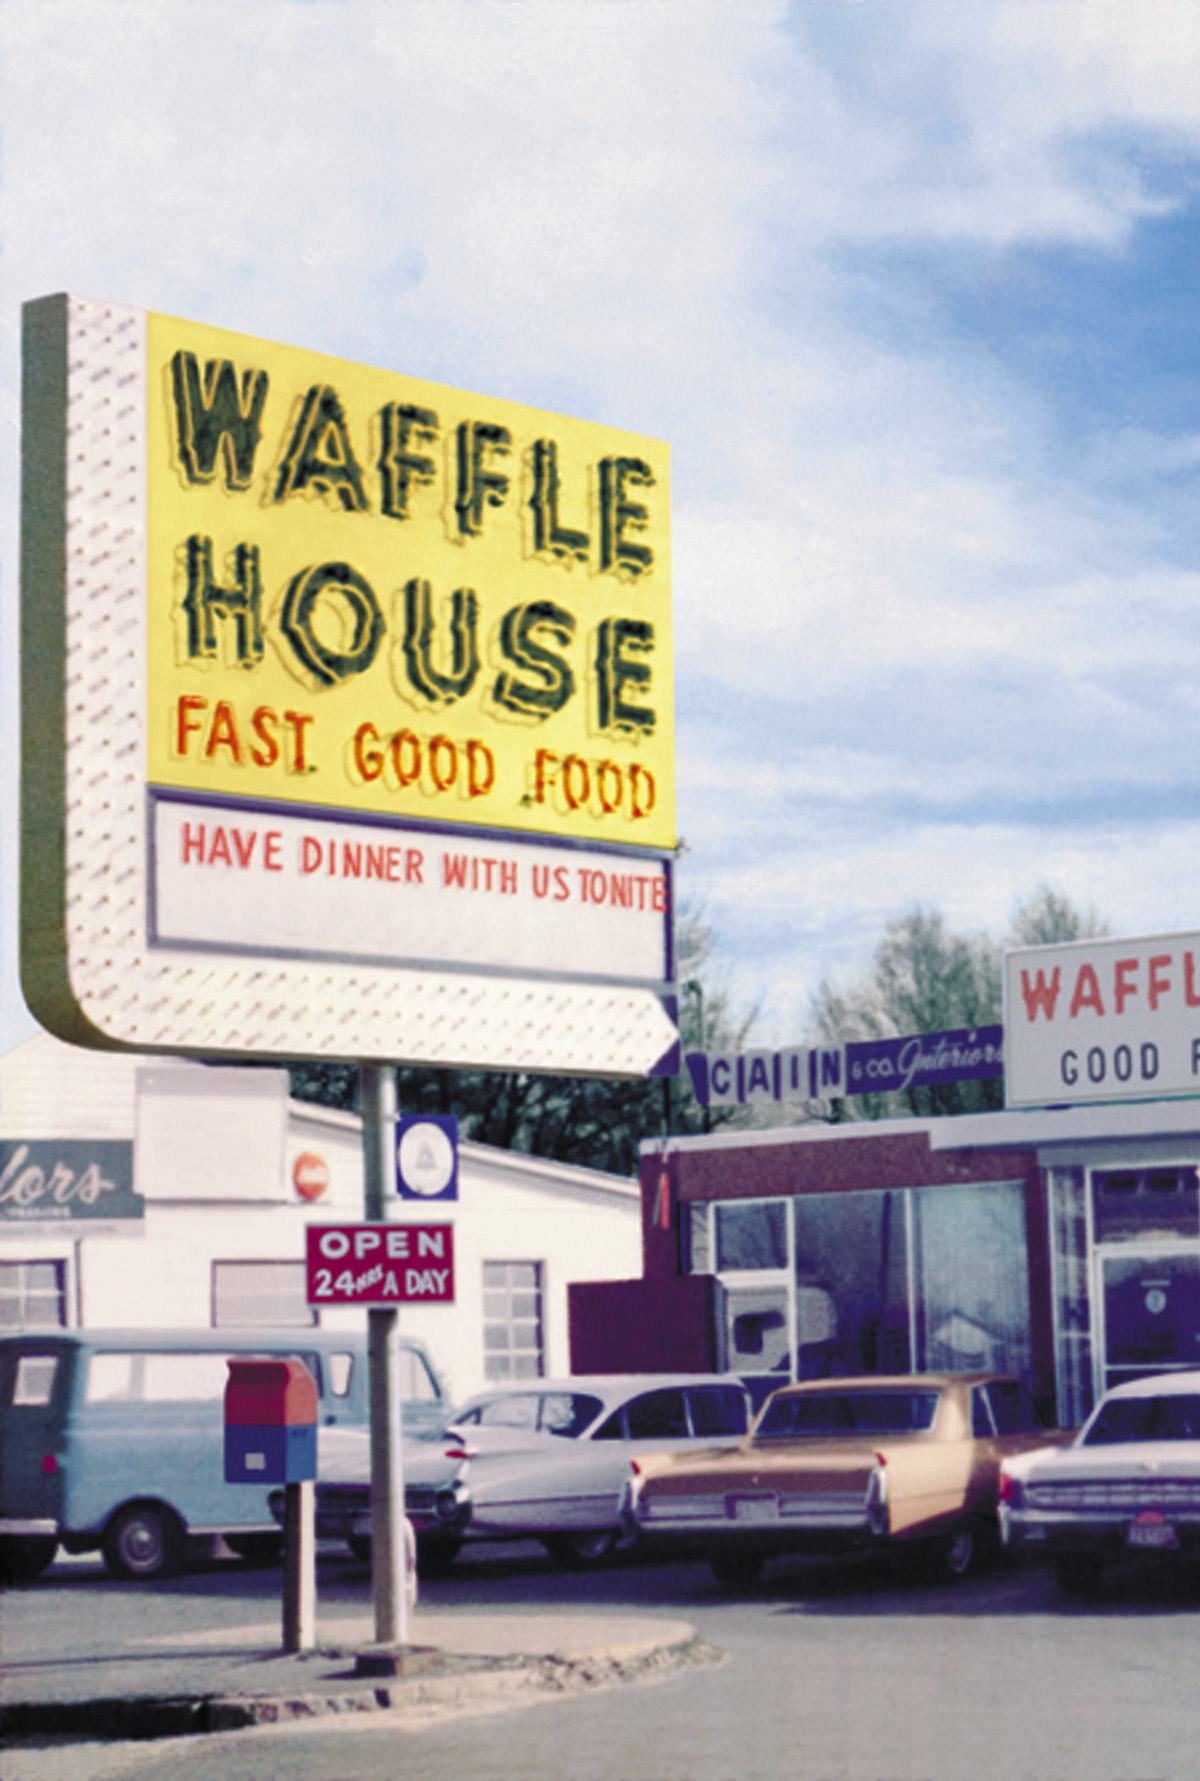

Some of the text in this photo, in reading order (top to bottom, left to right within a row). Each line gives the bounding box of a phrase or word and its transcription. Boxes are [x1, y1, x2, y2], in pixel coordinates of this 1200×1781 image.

[169, 350, 656, 576] WAFFLE
[180, 534, 656, 737] HOUSE
[176, 695, 656, 819] FAST GOOD FOOD
[181, 822, 667, 914] HAVE DINNER WITH US TONITE
[709, 1049, 841, 1096] CAIN
[1060, 1042, 1160, 1086] GOOD
[318, 1230, 445, 1260] OPEN
[382, 1269, 399, 1297] A
[405, 1268, 450, 1297] DAY
